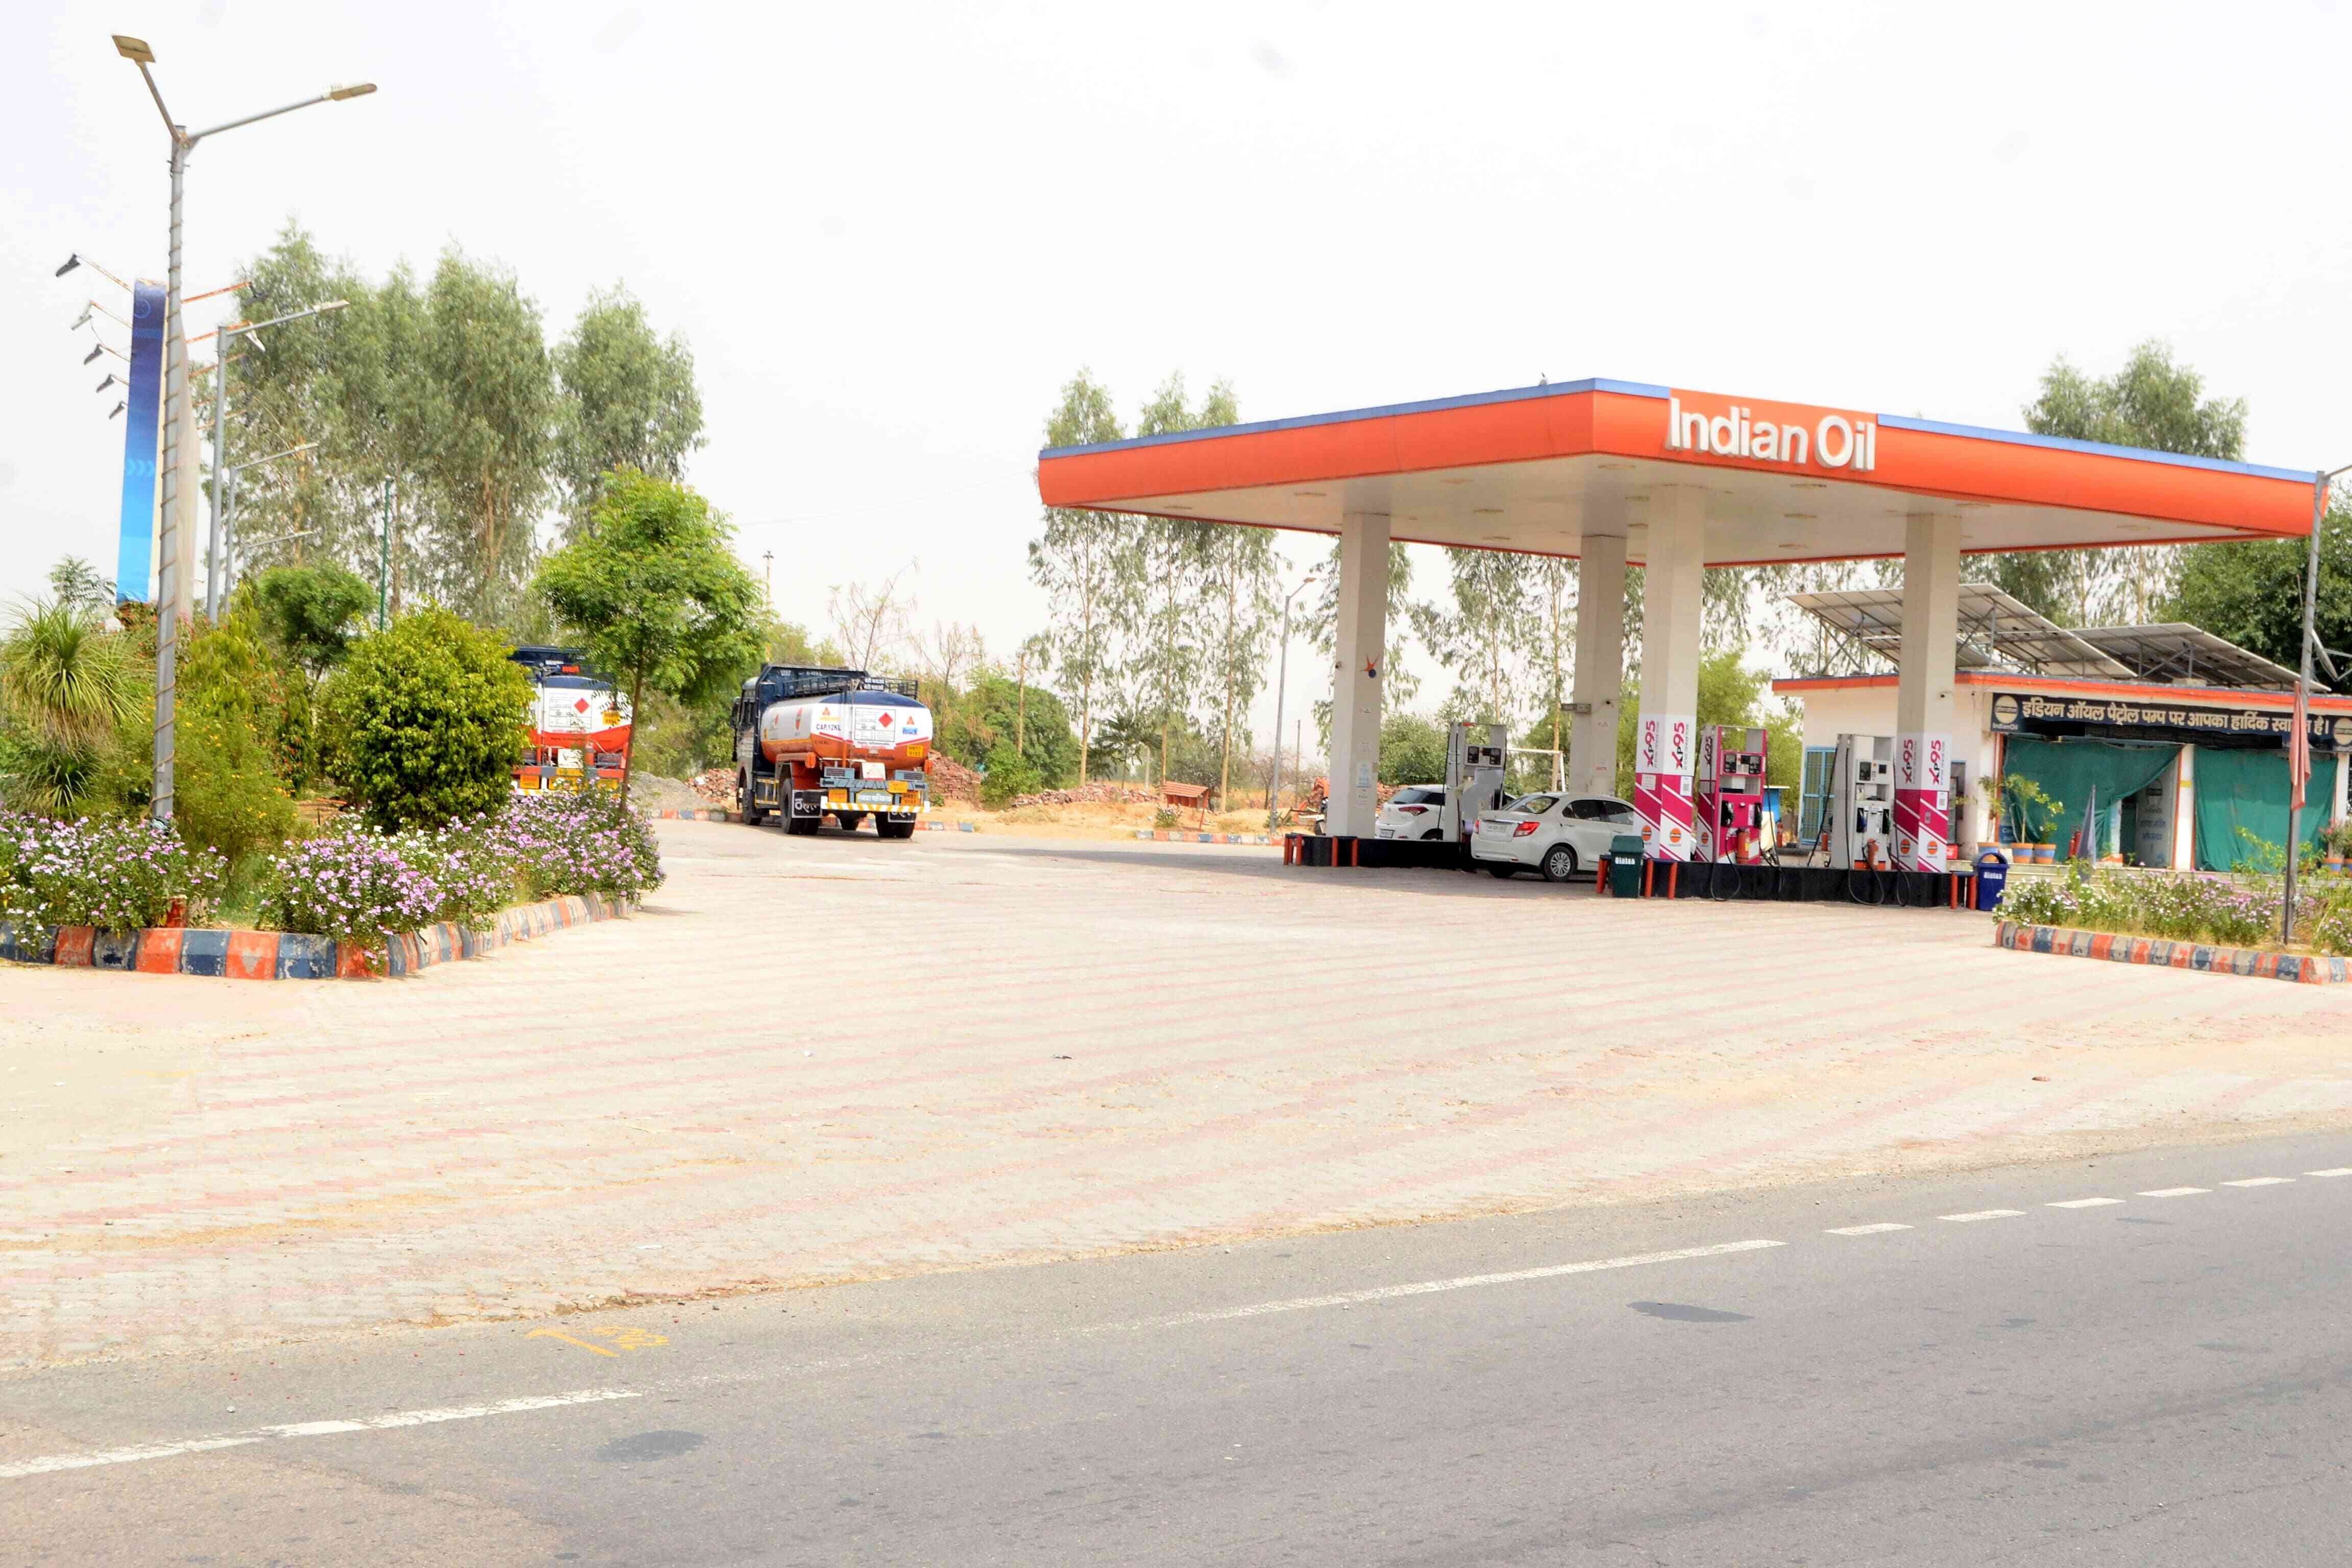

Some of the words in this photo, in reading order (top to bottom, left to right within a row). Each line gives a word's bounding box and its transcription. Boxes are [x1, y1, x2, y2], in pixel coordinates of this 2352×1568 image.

[1666, 397, 1808, 464] Indian
[1815, 415, 1876, 473] Oil
[2169, 711, 2187, 726] पर
[2188, 713, 2229, 728] आपका
[2231, 711, 2270, 730] हार्दिक
[1644, 720, 1655, 768] XP95
[1671, 722, 1685, 769] XP95
[1902, 739, 1913, 784] XP95
[1929, 740, 1941, 785] XP95
